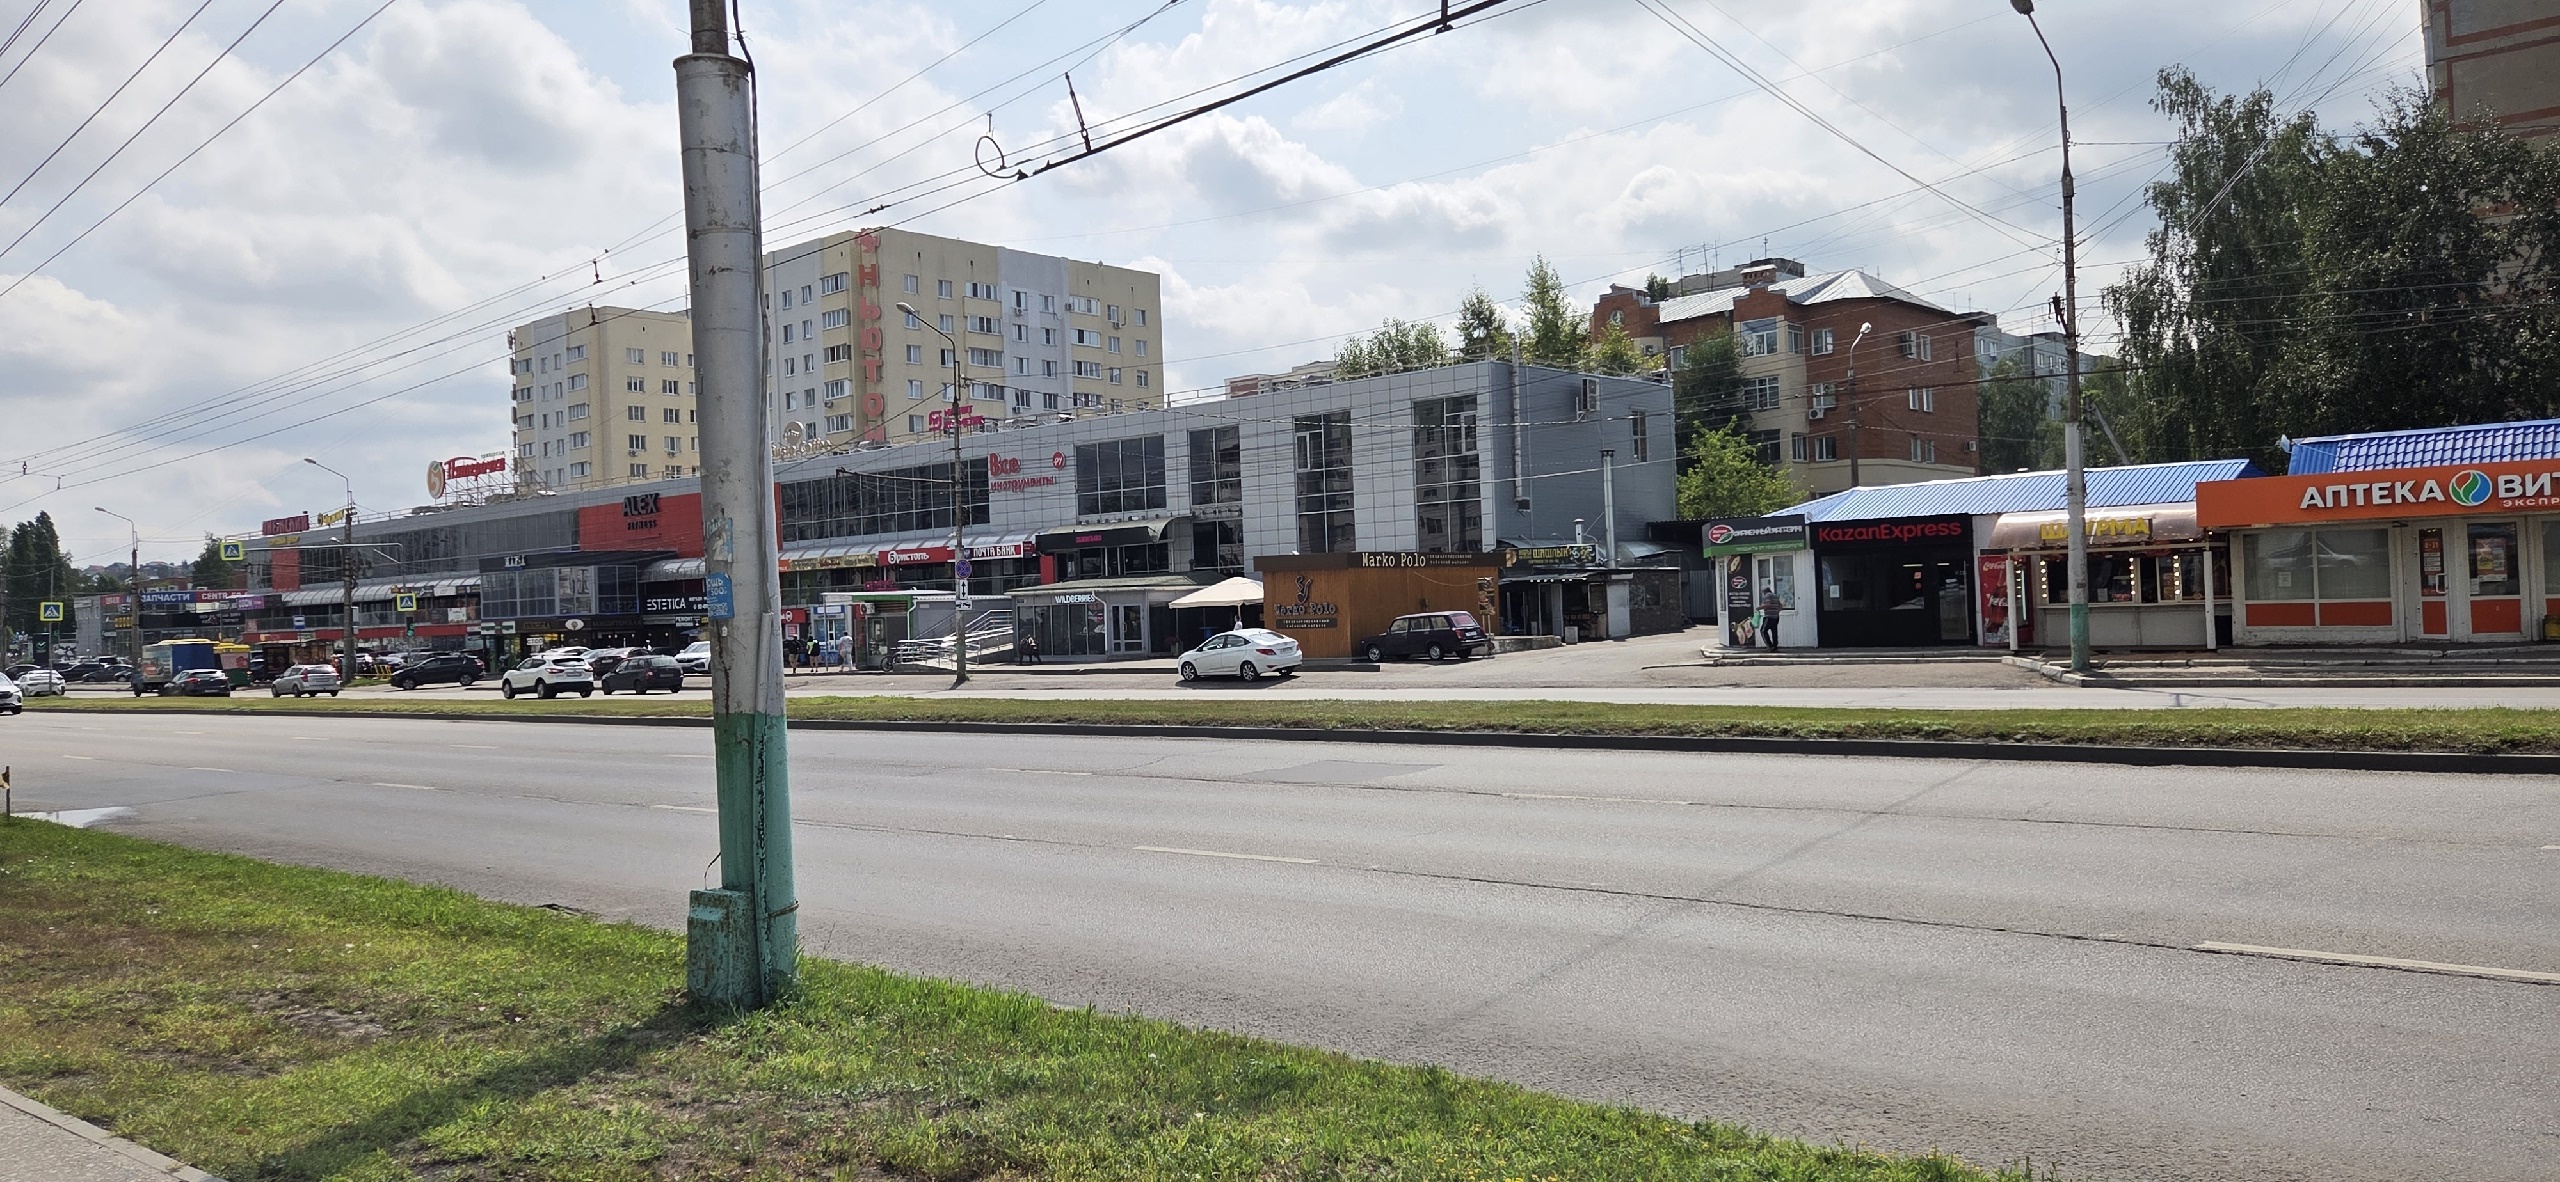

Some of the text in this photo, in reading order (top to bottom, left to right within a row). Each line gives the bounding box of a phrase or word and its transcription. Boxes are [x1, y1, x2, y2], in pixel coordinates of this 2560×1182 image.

[858, 263, 885, 441] НЬЮТОН
[989, 452, 1021, 477] Все
[2300, 479, 2446, 509] АПТЕКА
[623, 493, 660, 517] ALEX
[1819, 522, 1962, 542] KazanExpress
[2040, 517, 2150, 540] ШРМА
[888, 550, 930, 564] Бристоль
[973, 546, 995, 557] ПОЧТА
[996, 545, 1017, 556] БАНК
[1362, 552, 1426, 567] Marko Polo
[646, 597, 686, 611] ESTETICA
[1055, 594, 1096, 604] WILDBERRIES
